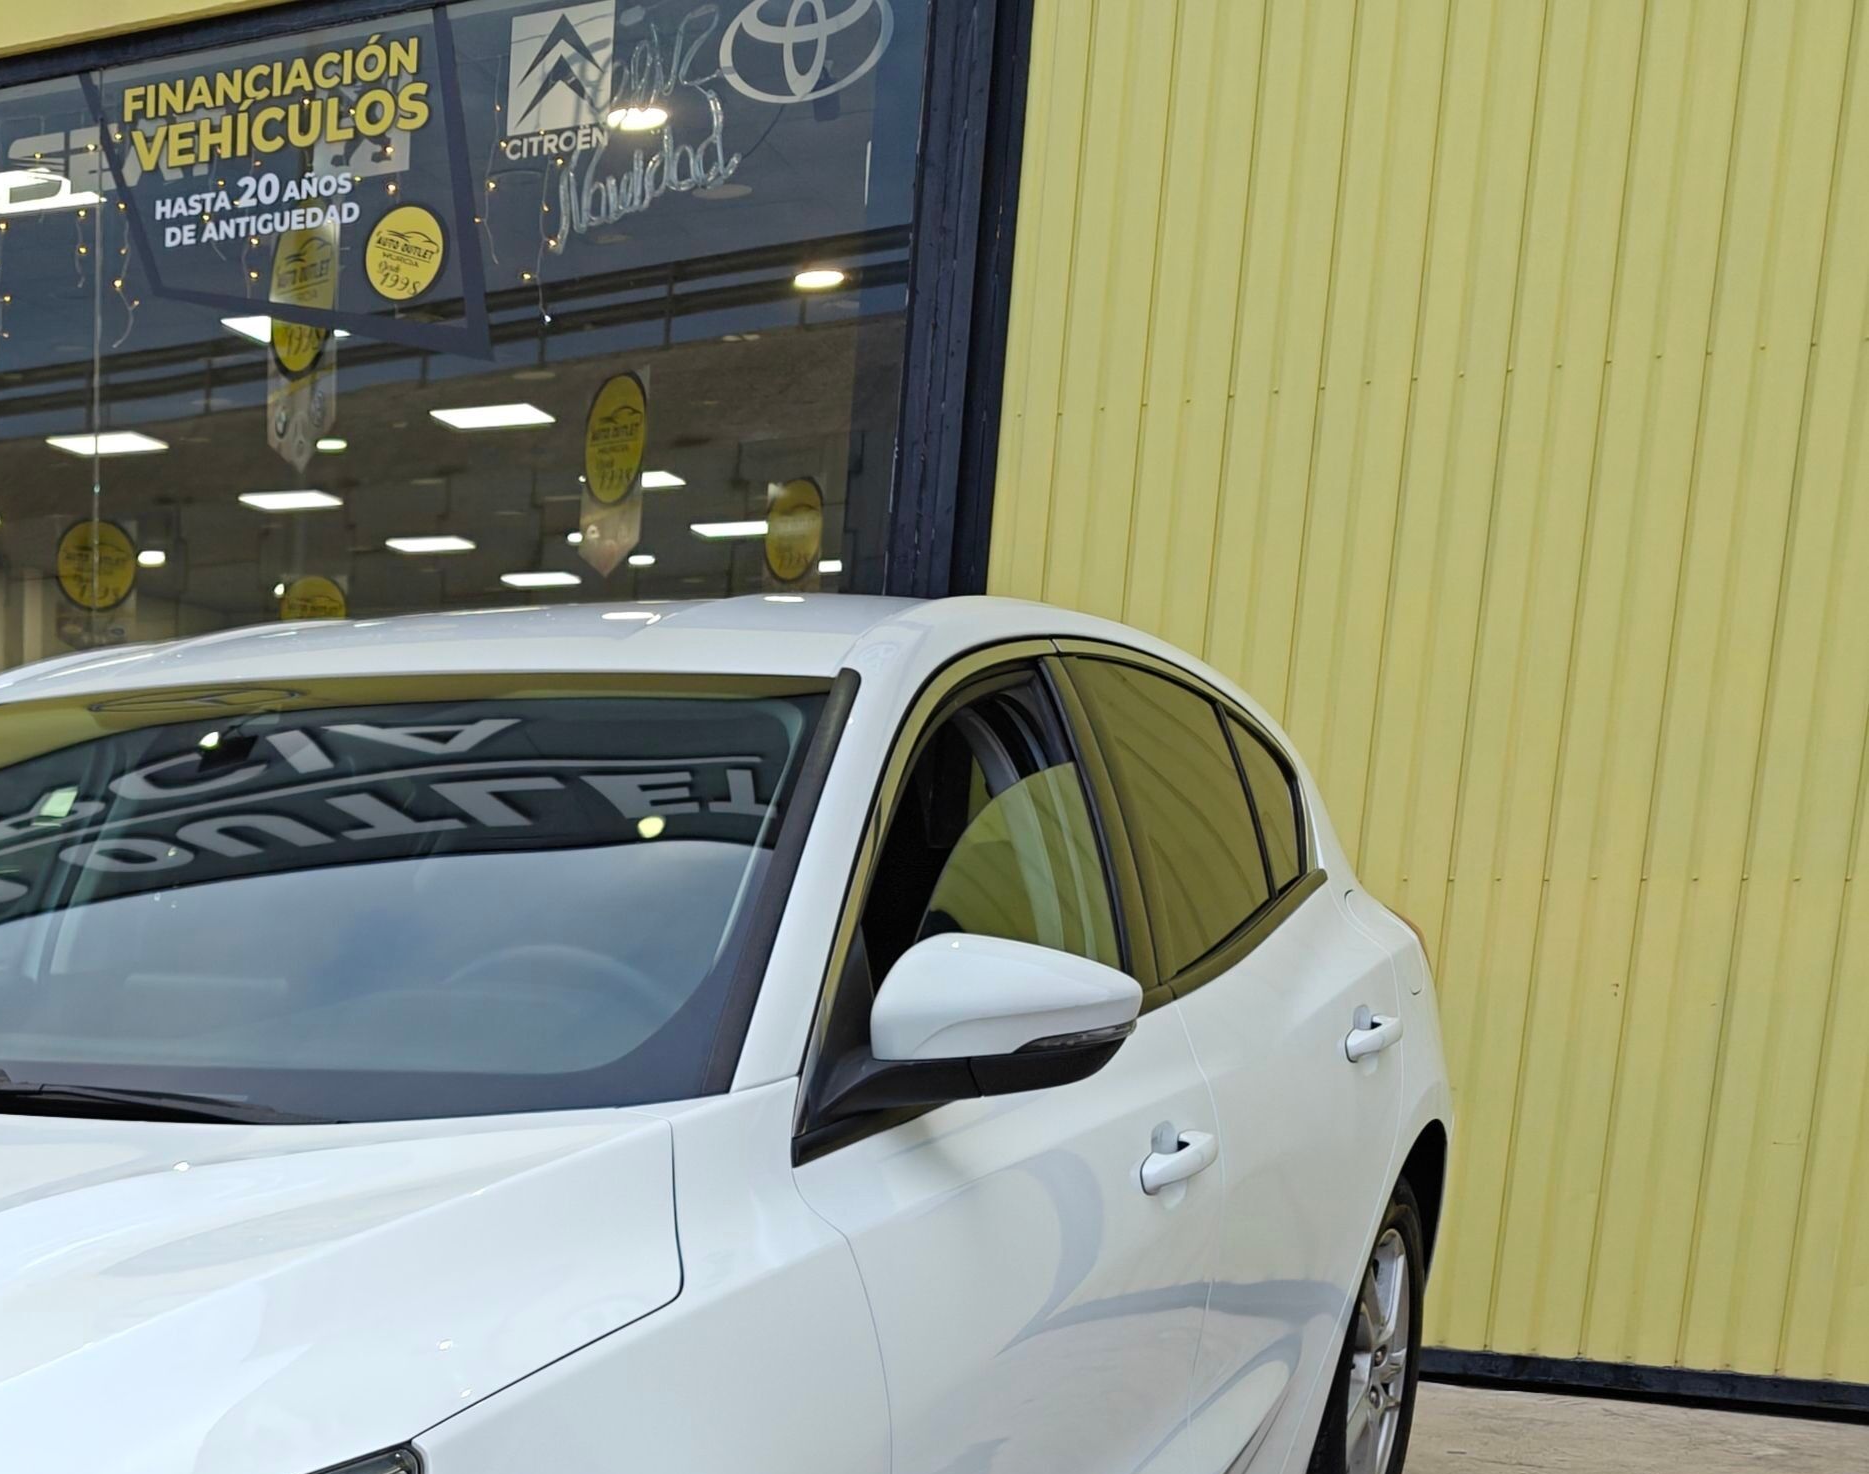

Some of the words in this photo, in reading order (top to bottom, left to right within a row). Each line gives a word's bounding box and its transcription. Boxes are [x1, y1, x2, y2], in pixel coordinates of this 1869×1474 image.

[123, 34, 419, 122] FINANCIACIÓN
[131, 82, 429, 172] VEHÍCULOS
[505, 123, 609, 160] CITROËN
[154, 192, 231, 221] HASTA
[235, 173, 280, 208] 20
[282, 172, 353, 201] AÑOS
[164, 226, 196, 248] DE
[200, 202, 360, 243] ANTIGUEDAD
[380, 272, 420, 296] 1998
